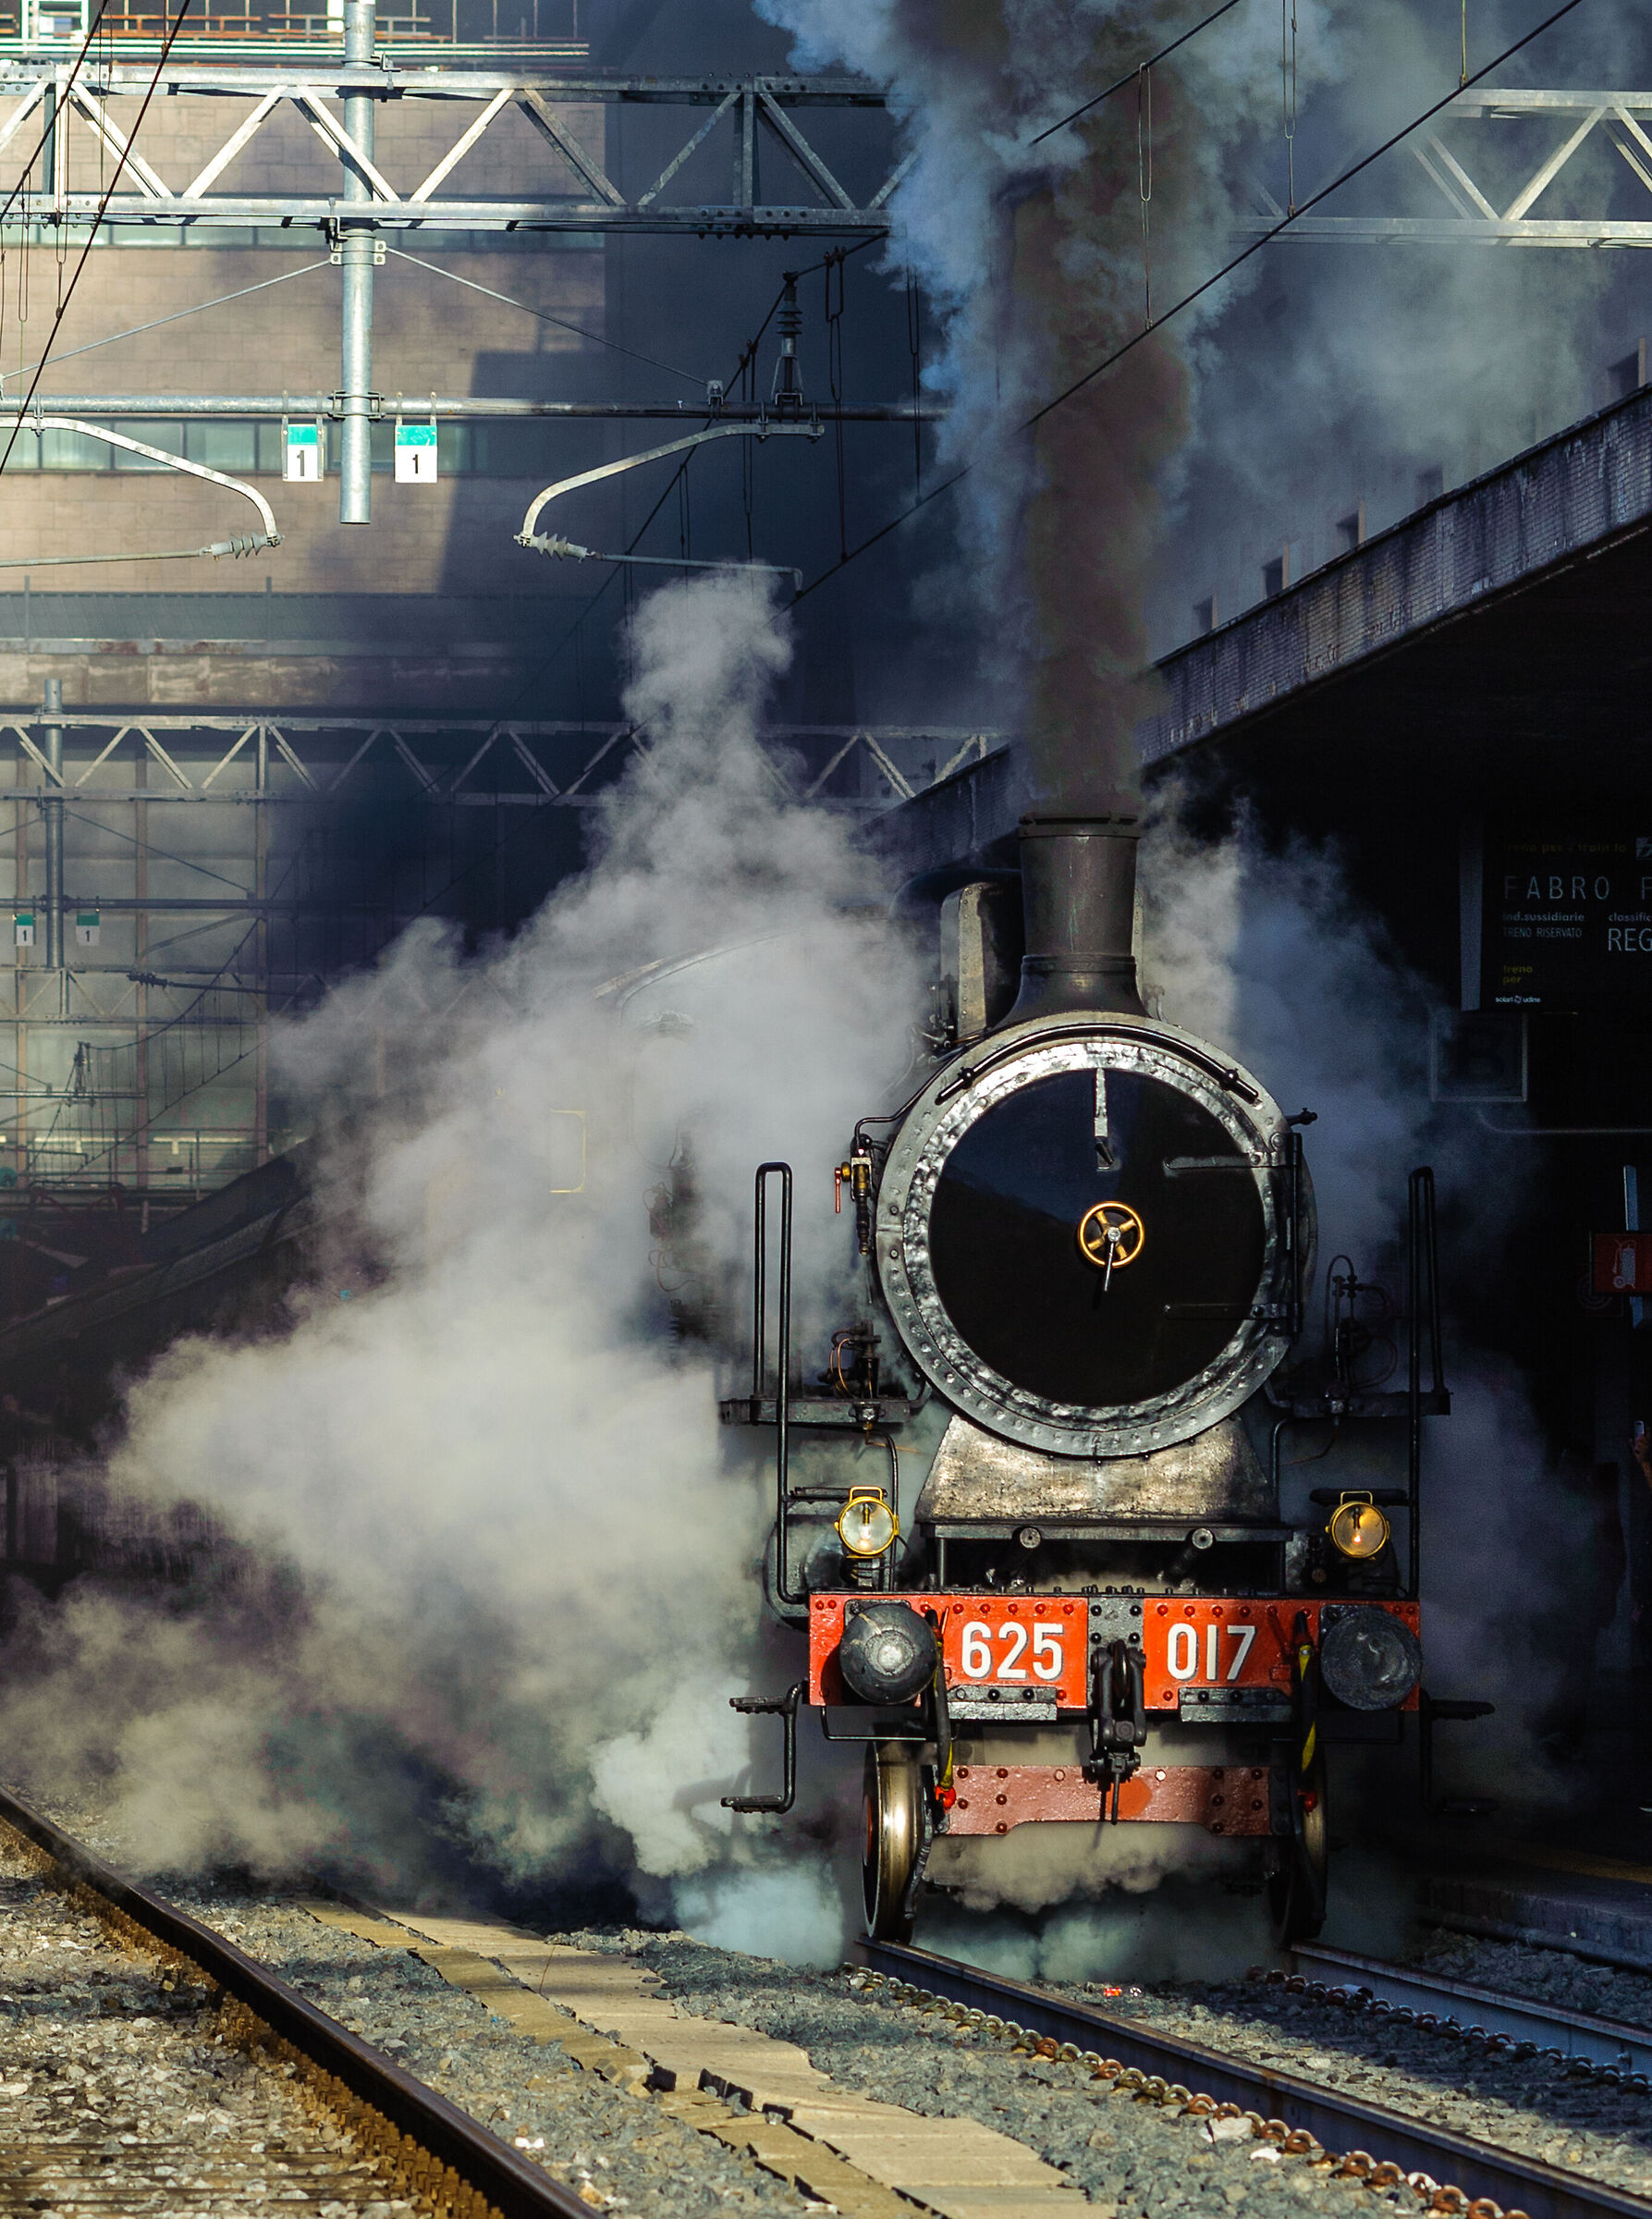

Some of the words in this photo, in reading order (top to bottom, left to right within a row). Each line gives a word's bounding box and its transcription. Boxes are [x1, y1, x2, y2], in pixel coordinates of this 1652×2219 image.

[297, 450, 305, 477] 1
[412, 454, 419, 474] 1
[1504, 876, 1610, 901] FABRO
[1502, 926, 1532, 938] TRENO
[1536, 926, 1583, 938] RISERVATO
[1608, 927, 1652, 952] REG
[1503, 964, 1534, 975] treno
[1502, 976, 1522, 986] per
[961, 1621, 1064, 1680] 625
[1167, 1623, 1255, 1681] 017
